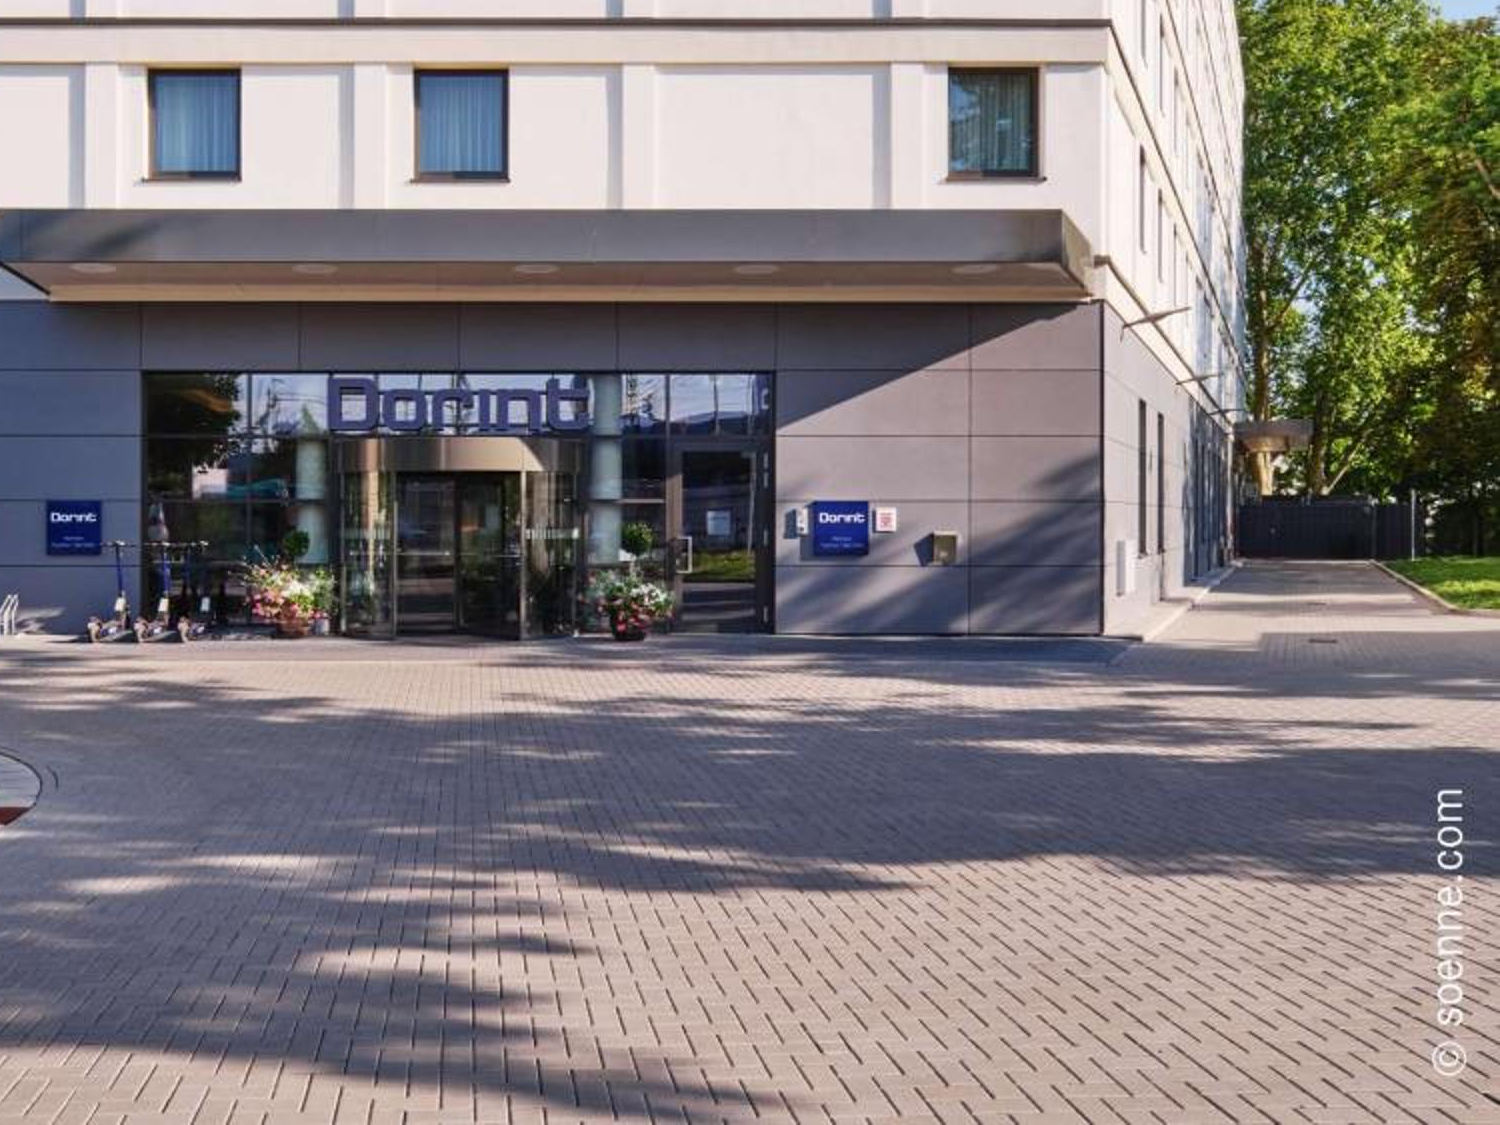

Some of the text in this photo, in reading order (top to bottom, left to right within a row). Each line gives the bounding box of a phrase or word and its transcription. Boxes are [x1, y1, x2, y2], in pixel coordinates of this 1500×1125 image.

[327, 377, 591, 431] Dorint
[51, 512, 97, 522] Dorint
[819, 512, 866, 524] Dorint
